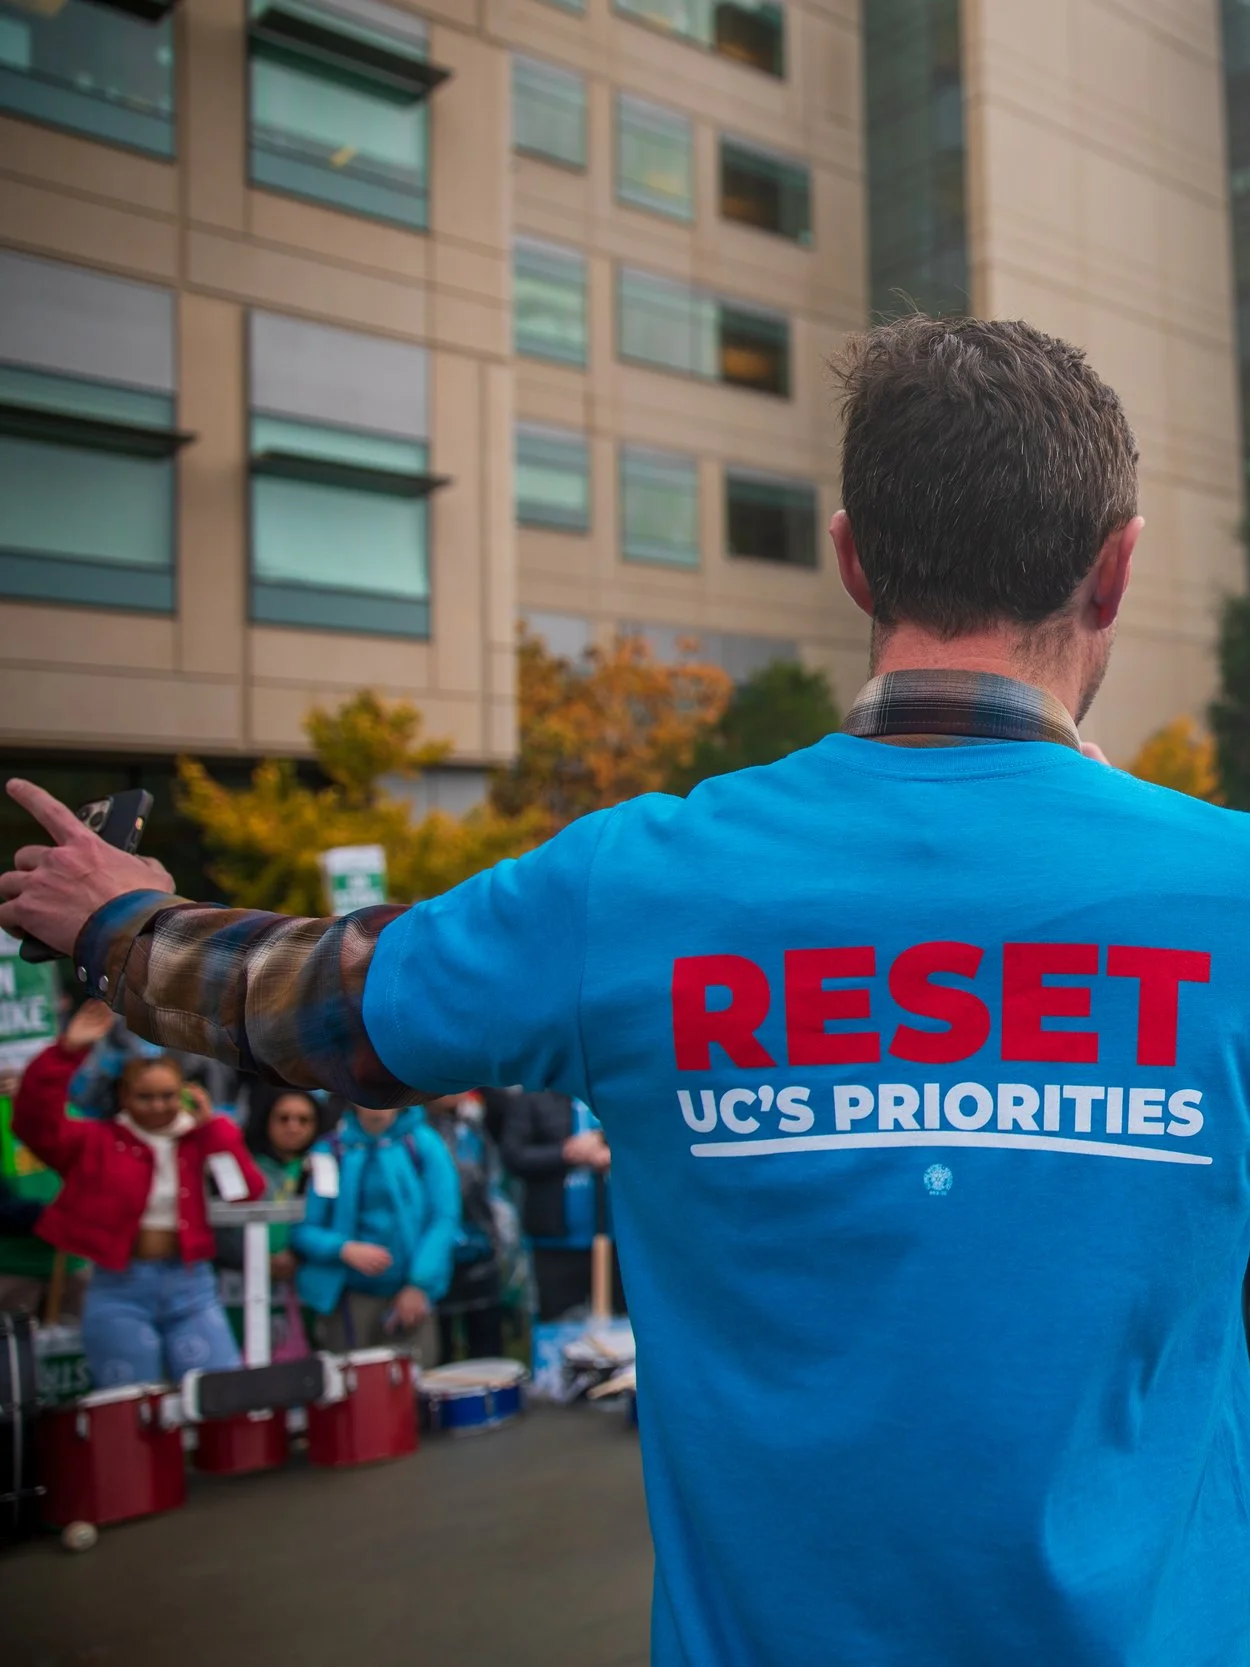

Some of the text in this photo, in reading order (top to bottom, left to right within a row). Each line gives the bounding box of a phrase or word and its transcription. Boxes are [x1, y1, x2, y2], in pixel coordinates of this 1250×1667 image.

[671, 941, 1212, 1071] RESET
[677, 1085, 815, 1134] UC'S
[834, 1082, 1204, 1137] PRIORITIES
